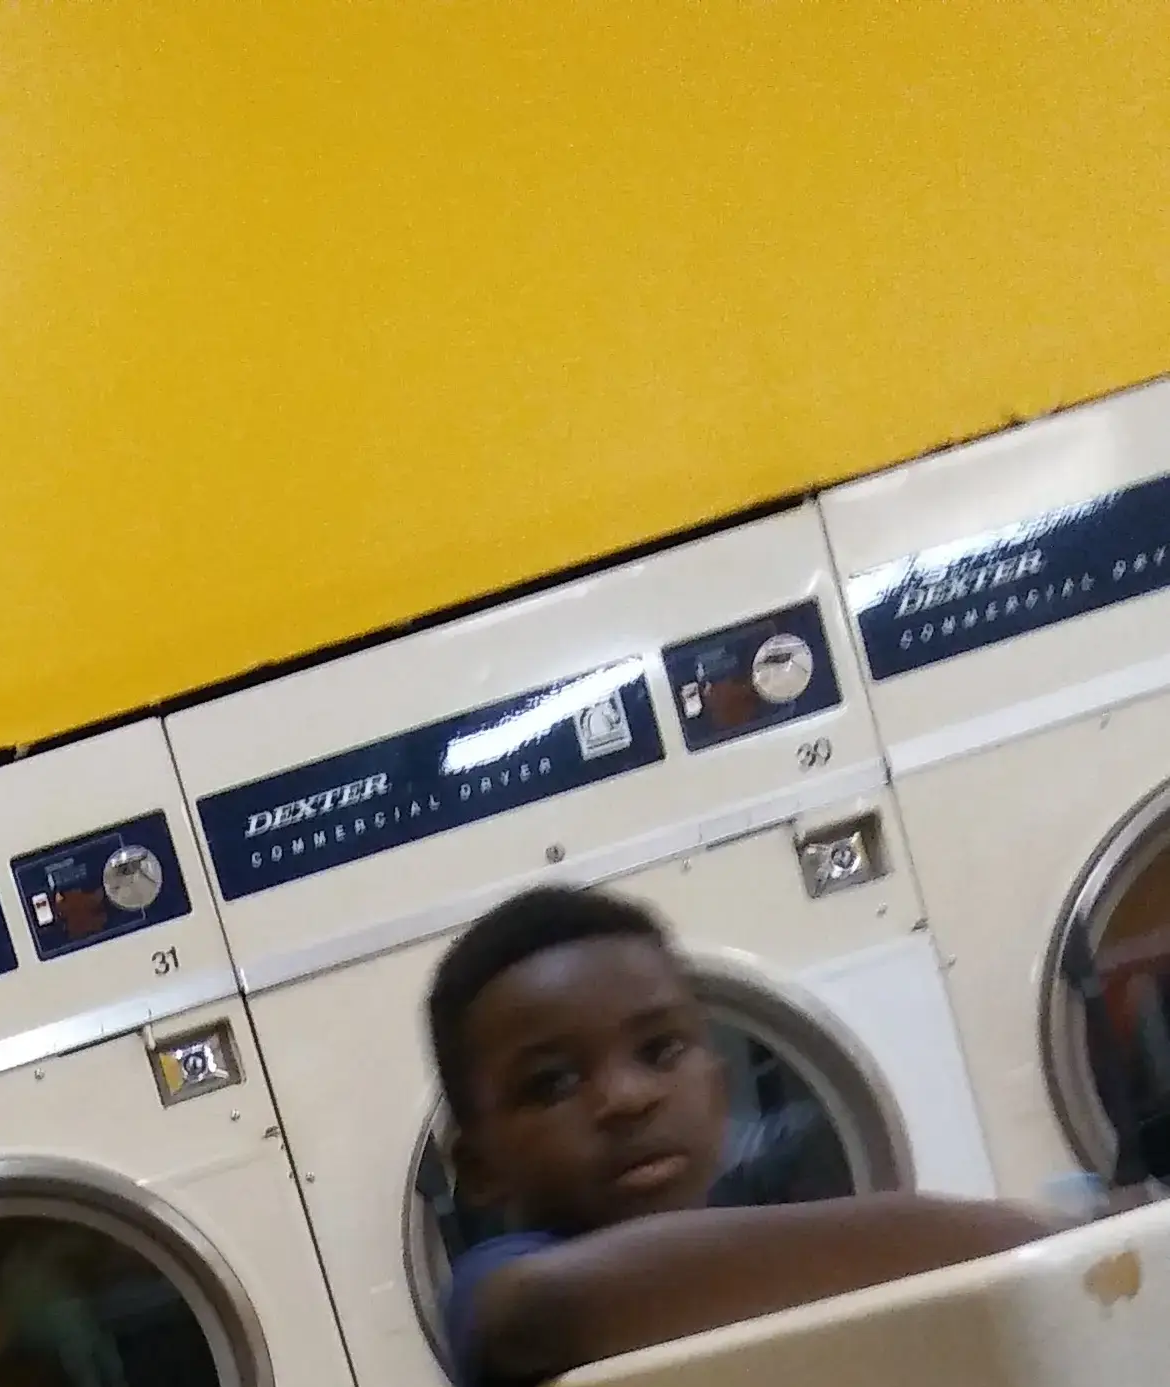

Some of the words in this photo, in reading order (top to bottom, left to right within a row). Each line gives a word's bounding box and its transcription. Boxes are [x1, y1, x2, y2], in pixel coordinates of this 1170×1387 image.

[244, 772, 388, 838] DEXTER
[251, 793, 441, 868] COMMERCIAL
[459, 755, 552, 801] DRYER
[151, 945, 179, 975] 31
